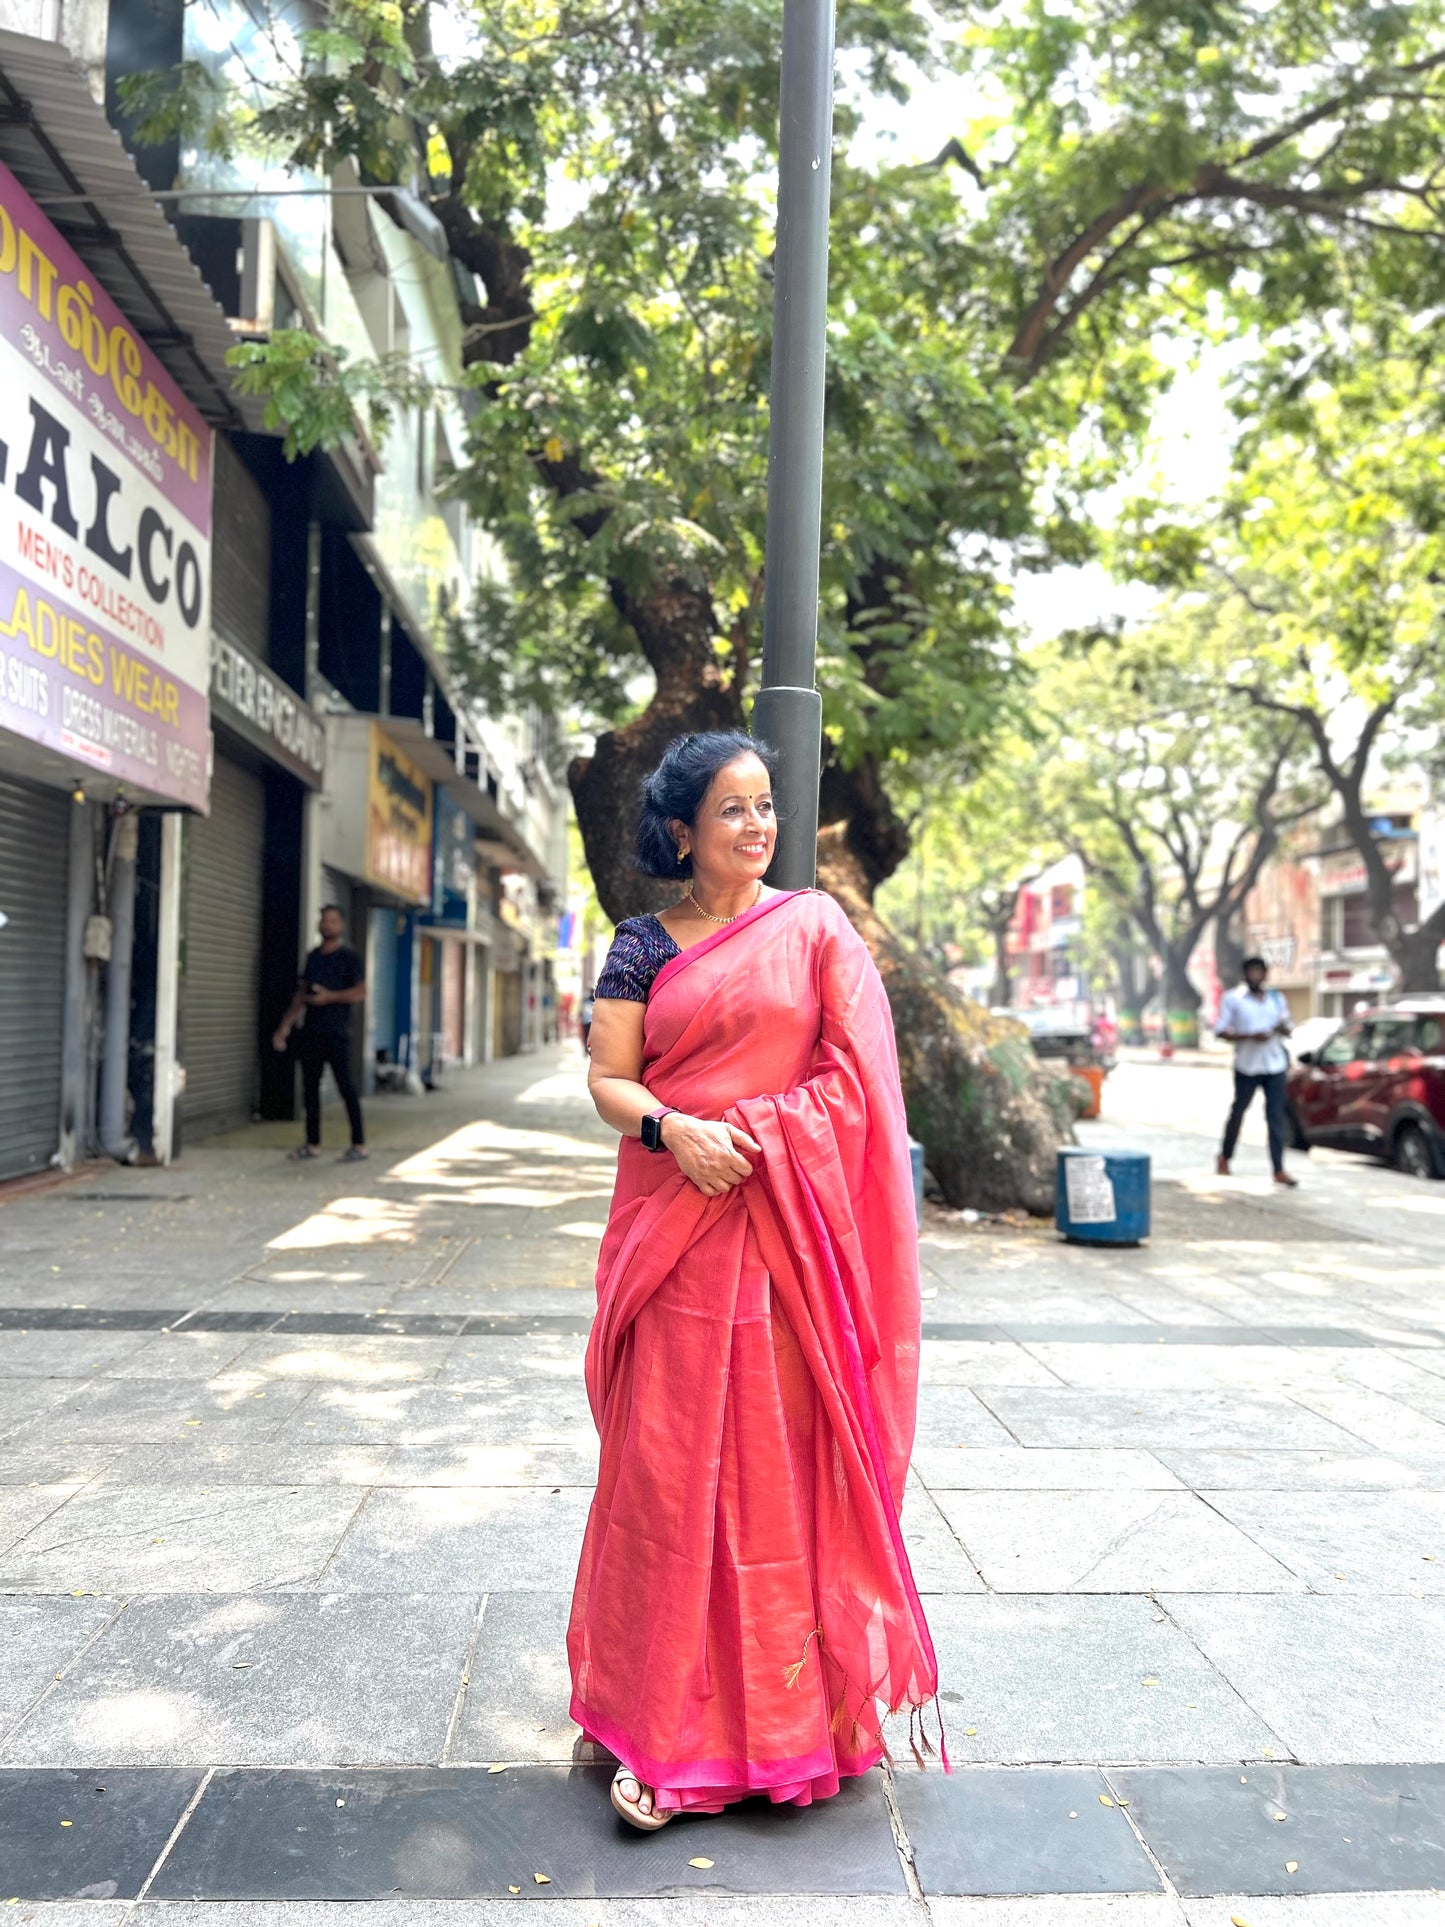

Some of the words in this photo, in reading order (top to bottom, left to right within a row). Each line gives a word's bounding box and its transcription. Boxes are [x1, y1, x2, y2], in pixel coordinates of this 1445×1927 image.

[18, 520, 74, 589] MEN'S
[77, 566, 165, 650] COLLECTION
[7, 656, 49, 718] SUITS
[110, 646, 181, 729] WEAR
